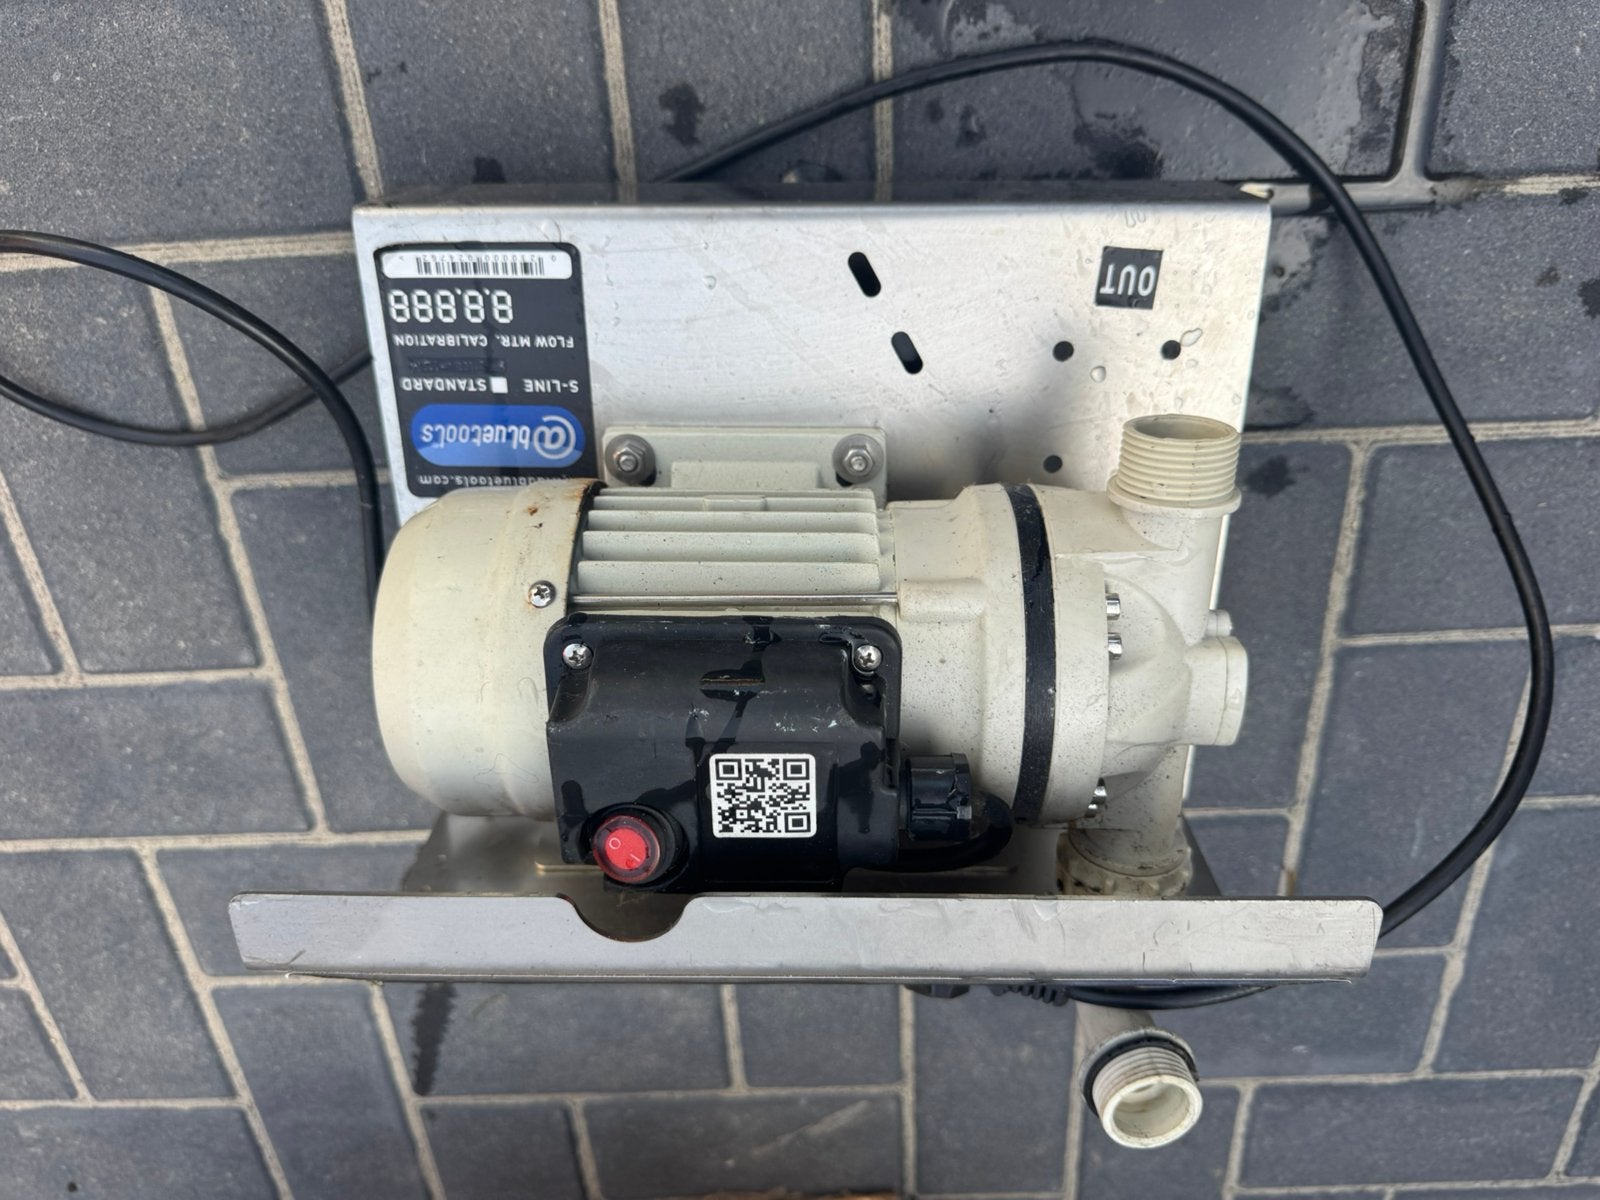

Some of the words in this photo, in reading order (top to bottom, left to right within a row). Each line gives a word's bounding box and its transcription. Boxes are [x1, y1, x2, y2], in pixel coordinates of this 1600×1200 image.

[1099, 263, 1156, 297] OUT
[393, 333, 488, 347] CALIBRATION
[496, 334, 531, 348] MTR.
[536, 335, 575, 348] FLOW
[400, 377, 487, 392] STANDARD
[522, 378, 579, 393] S-LINE
